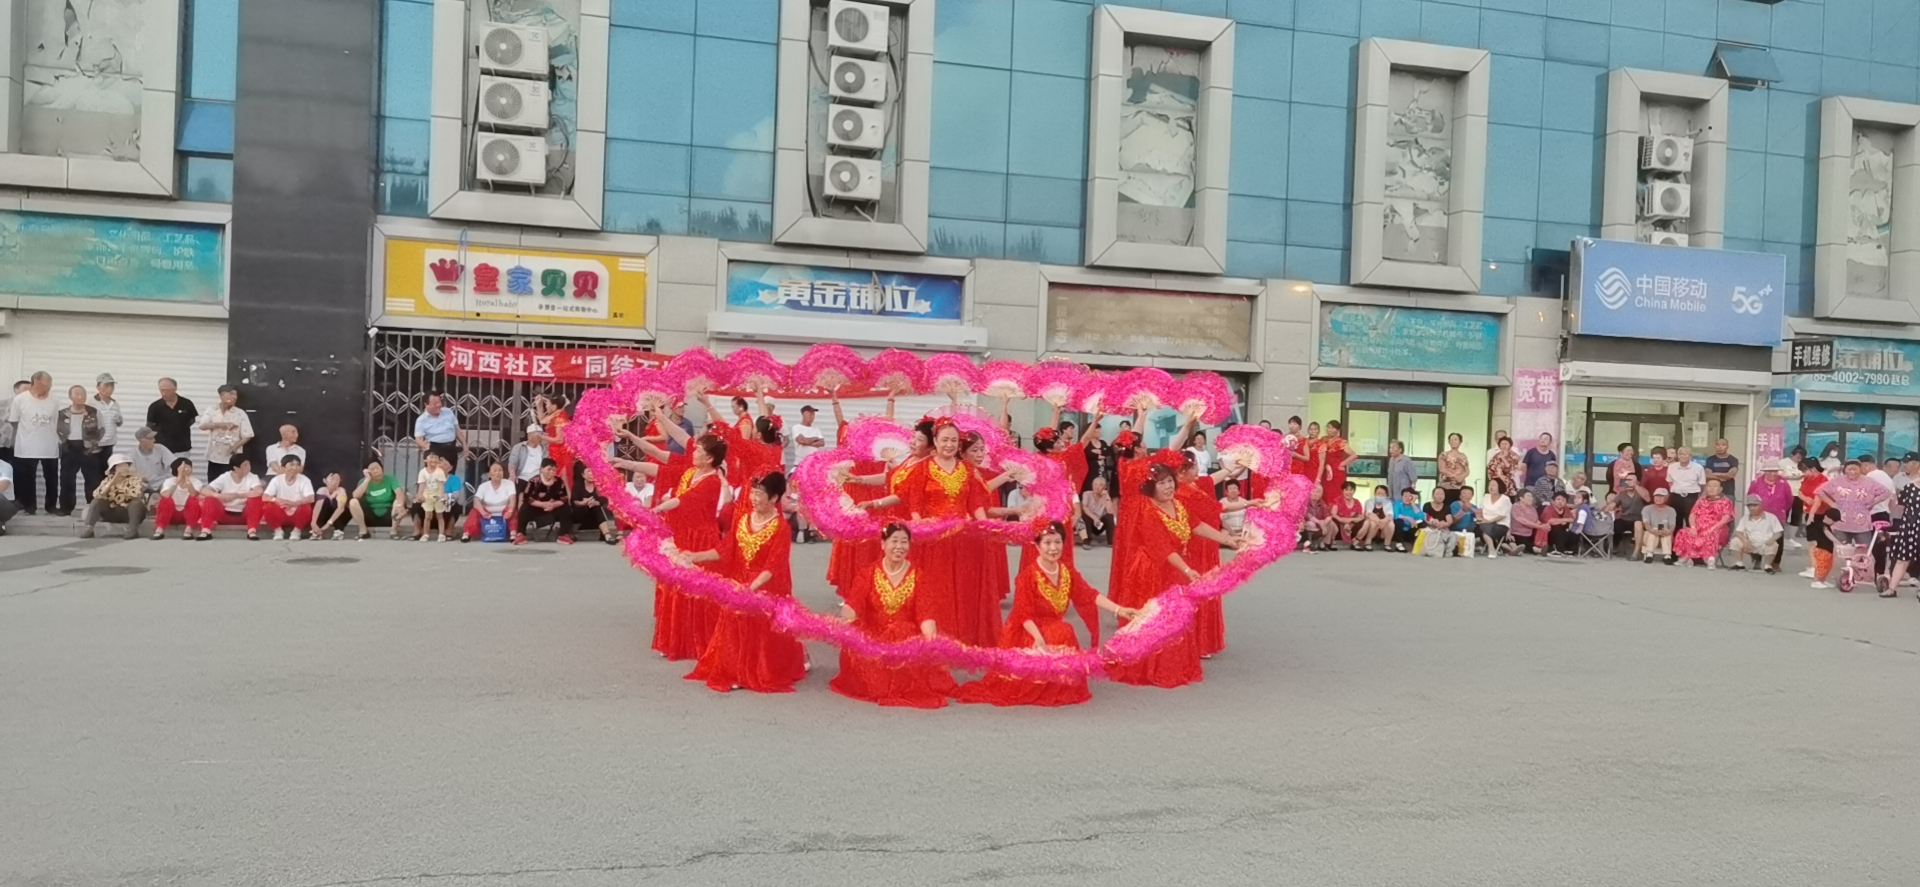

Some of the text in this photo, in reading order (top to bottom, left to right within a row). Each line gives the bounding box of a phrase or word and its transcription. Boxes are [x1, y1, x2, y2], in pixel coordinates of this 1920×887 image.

[473, 262, 599, 300] 皇家贝贝
[1636, 274, 1708, 299] 中国移动
[778, 278, 917, 313] 黄金铺位
[1634, 296, 1707, 313] China Mobile
[1793, 343, 1831, 368] 手机维修
[1516, 375, 1557, 405] 宽带
[1757, 433, 1781, 452] 手机
